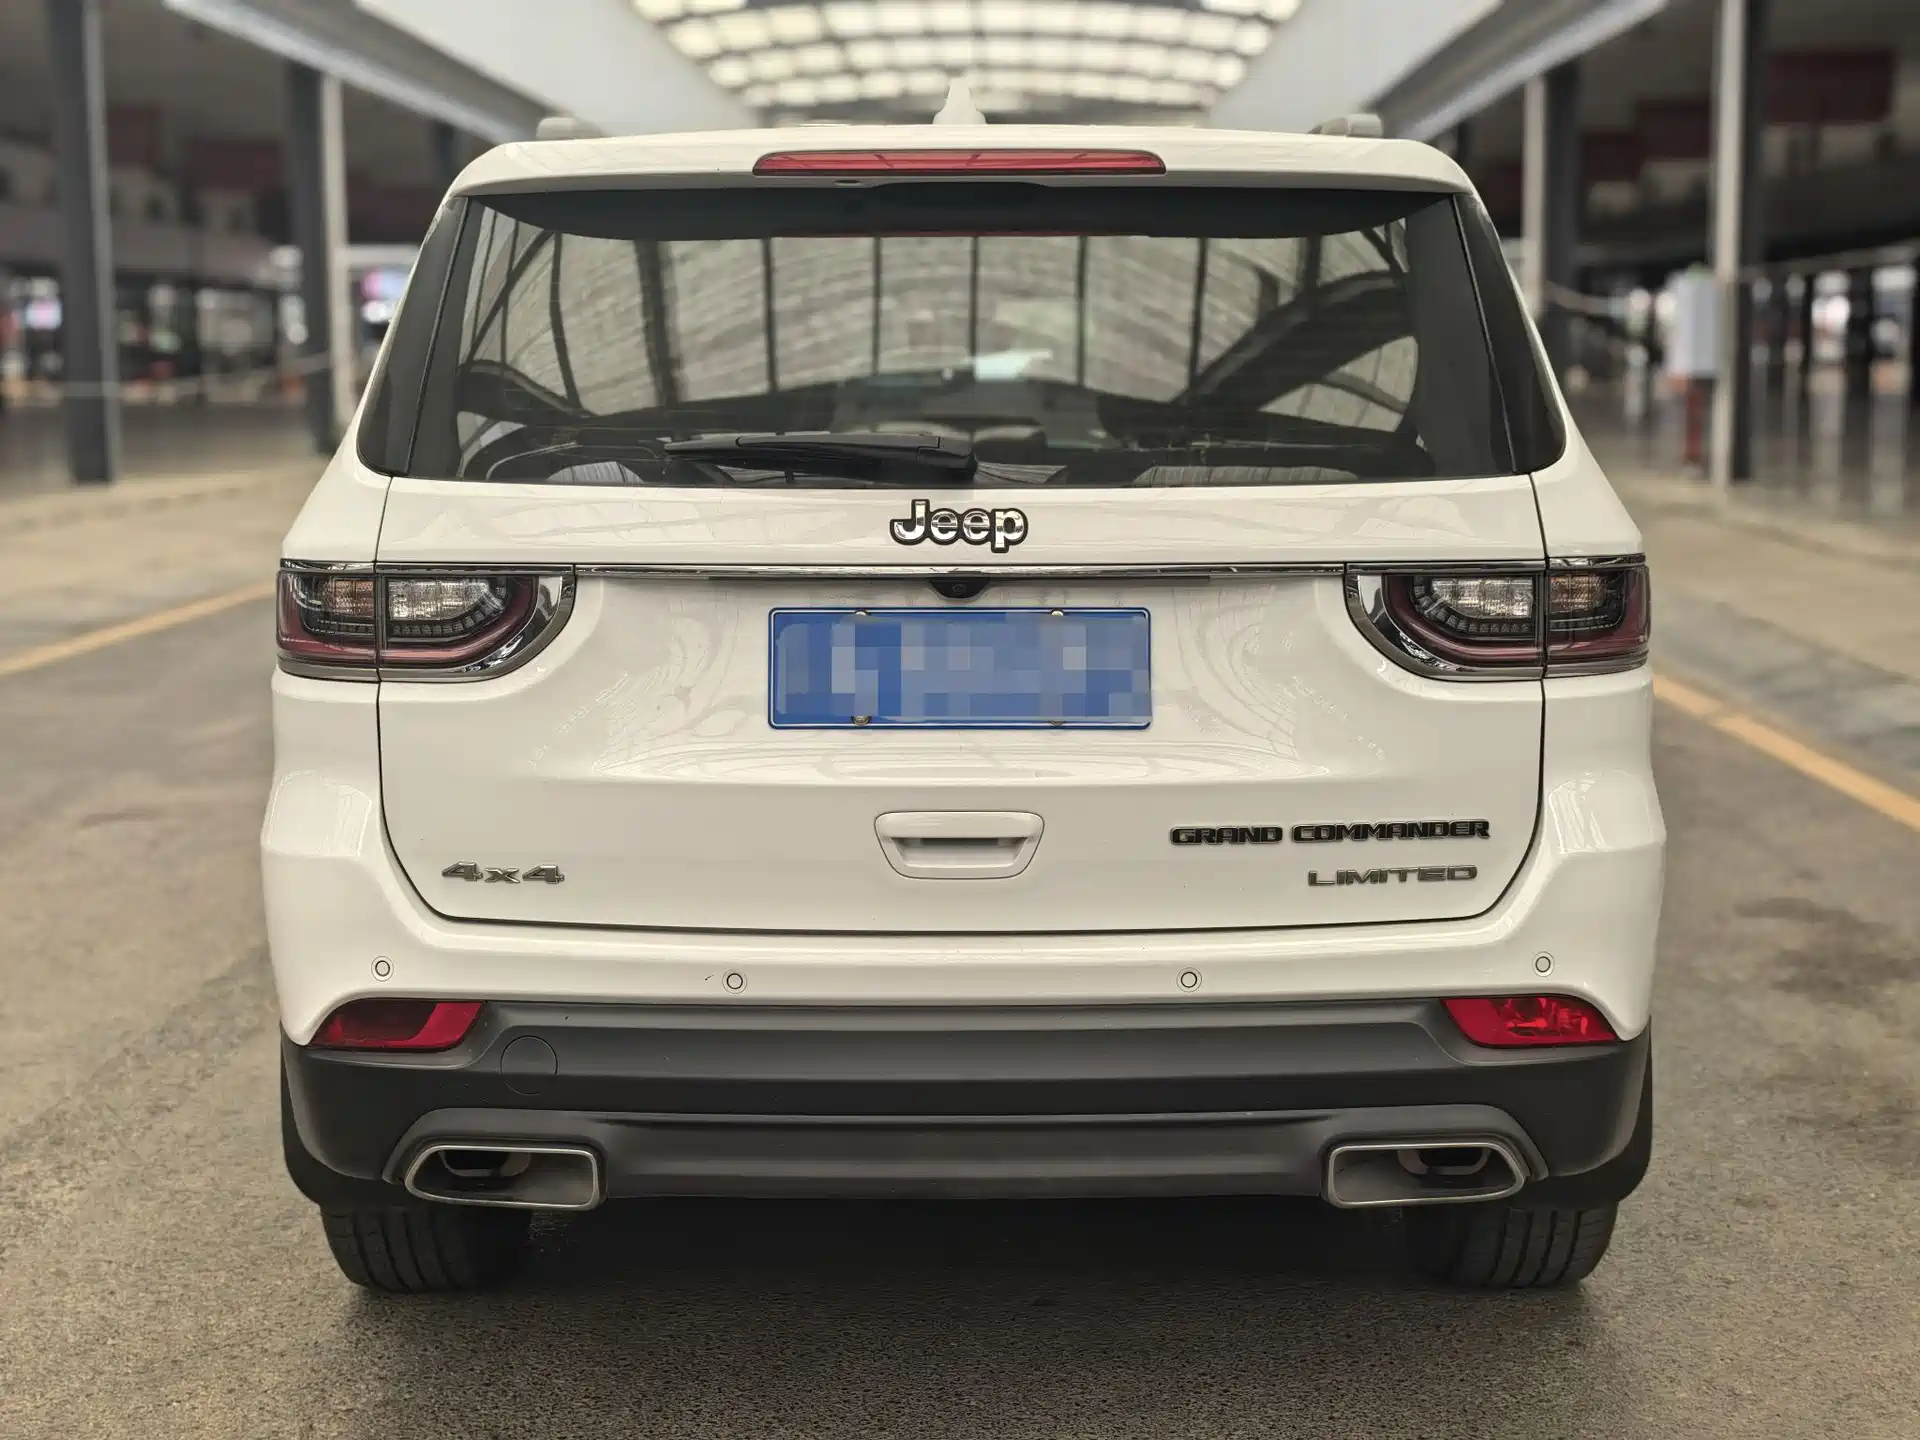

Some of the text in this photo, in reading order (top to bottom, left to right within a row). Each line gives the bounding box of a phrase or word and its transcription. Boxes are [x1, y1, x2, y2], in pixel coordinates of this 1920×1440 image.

[890, 499, 1028, 553] Jeep
[1170, 819, 1490, 845] GRAND COMMANDER
[441, 861, 565, 884] 4x4
[1308, 865, 1478, 886] LIMITED
